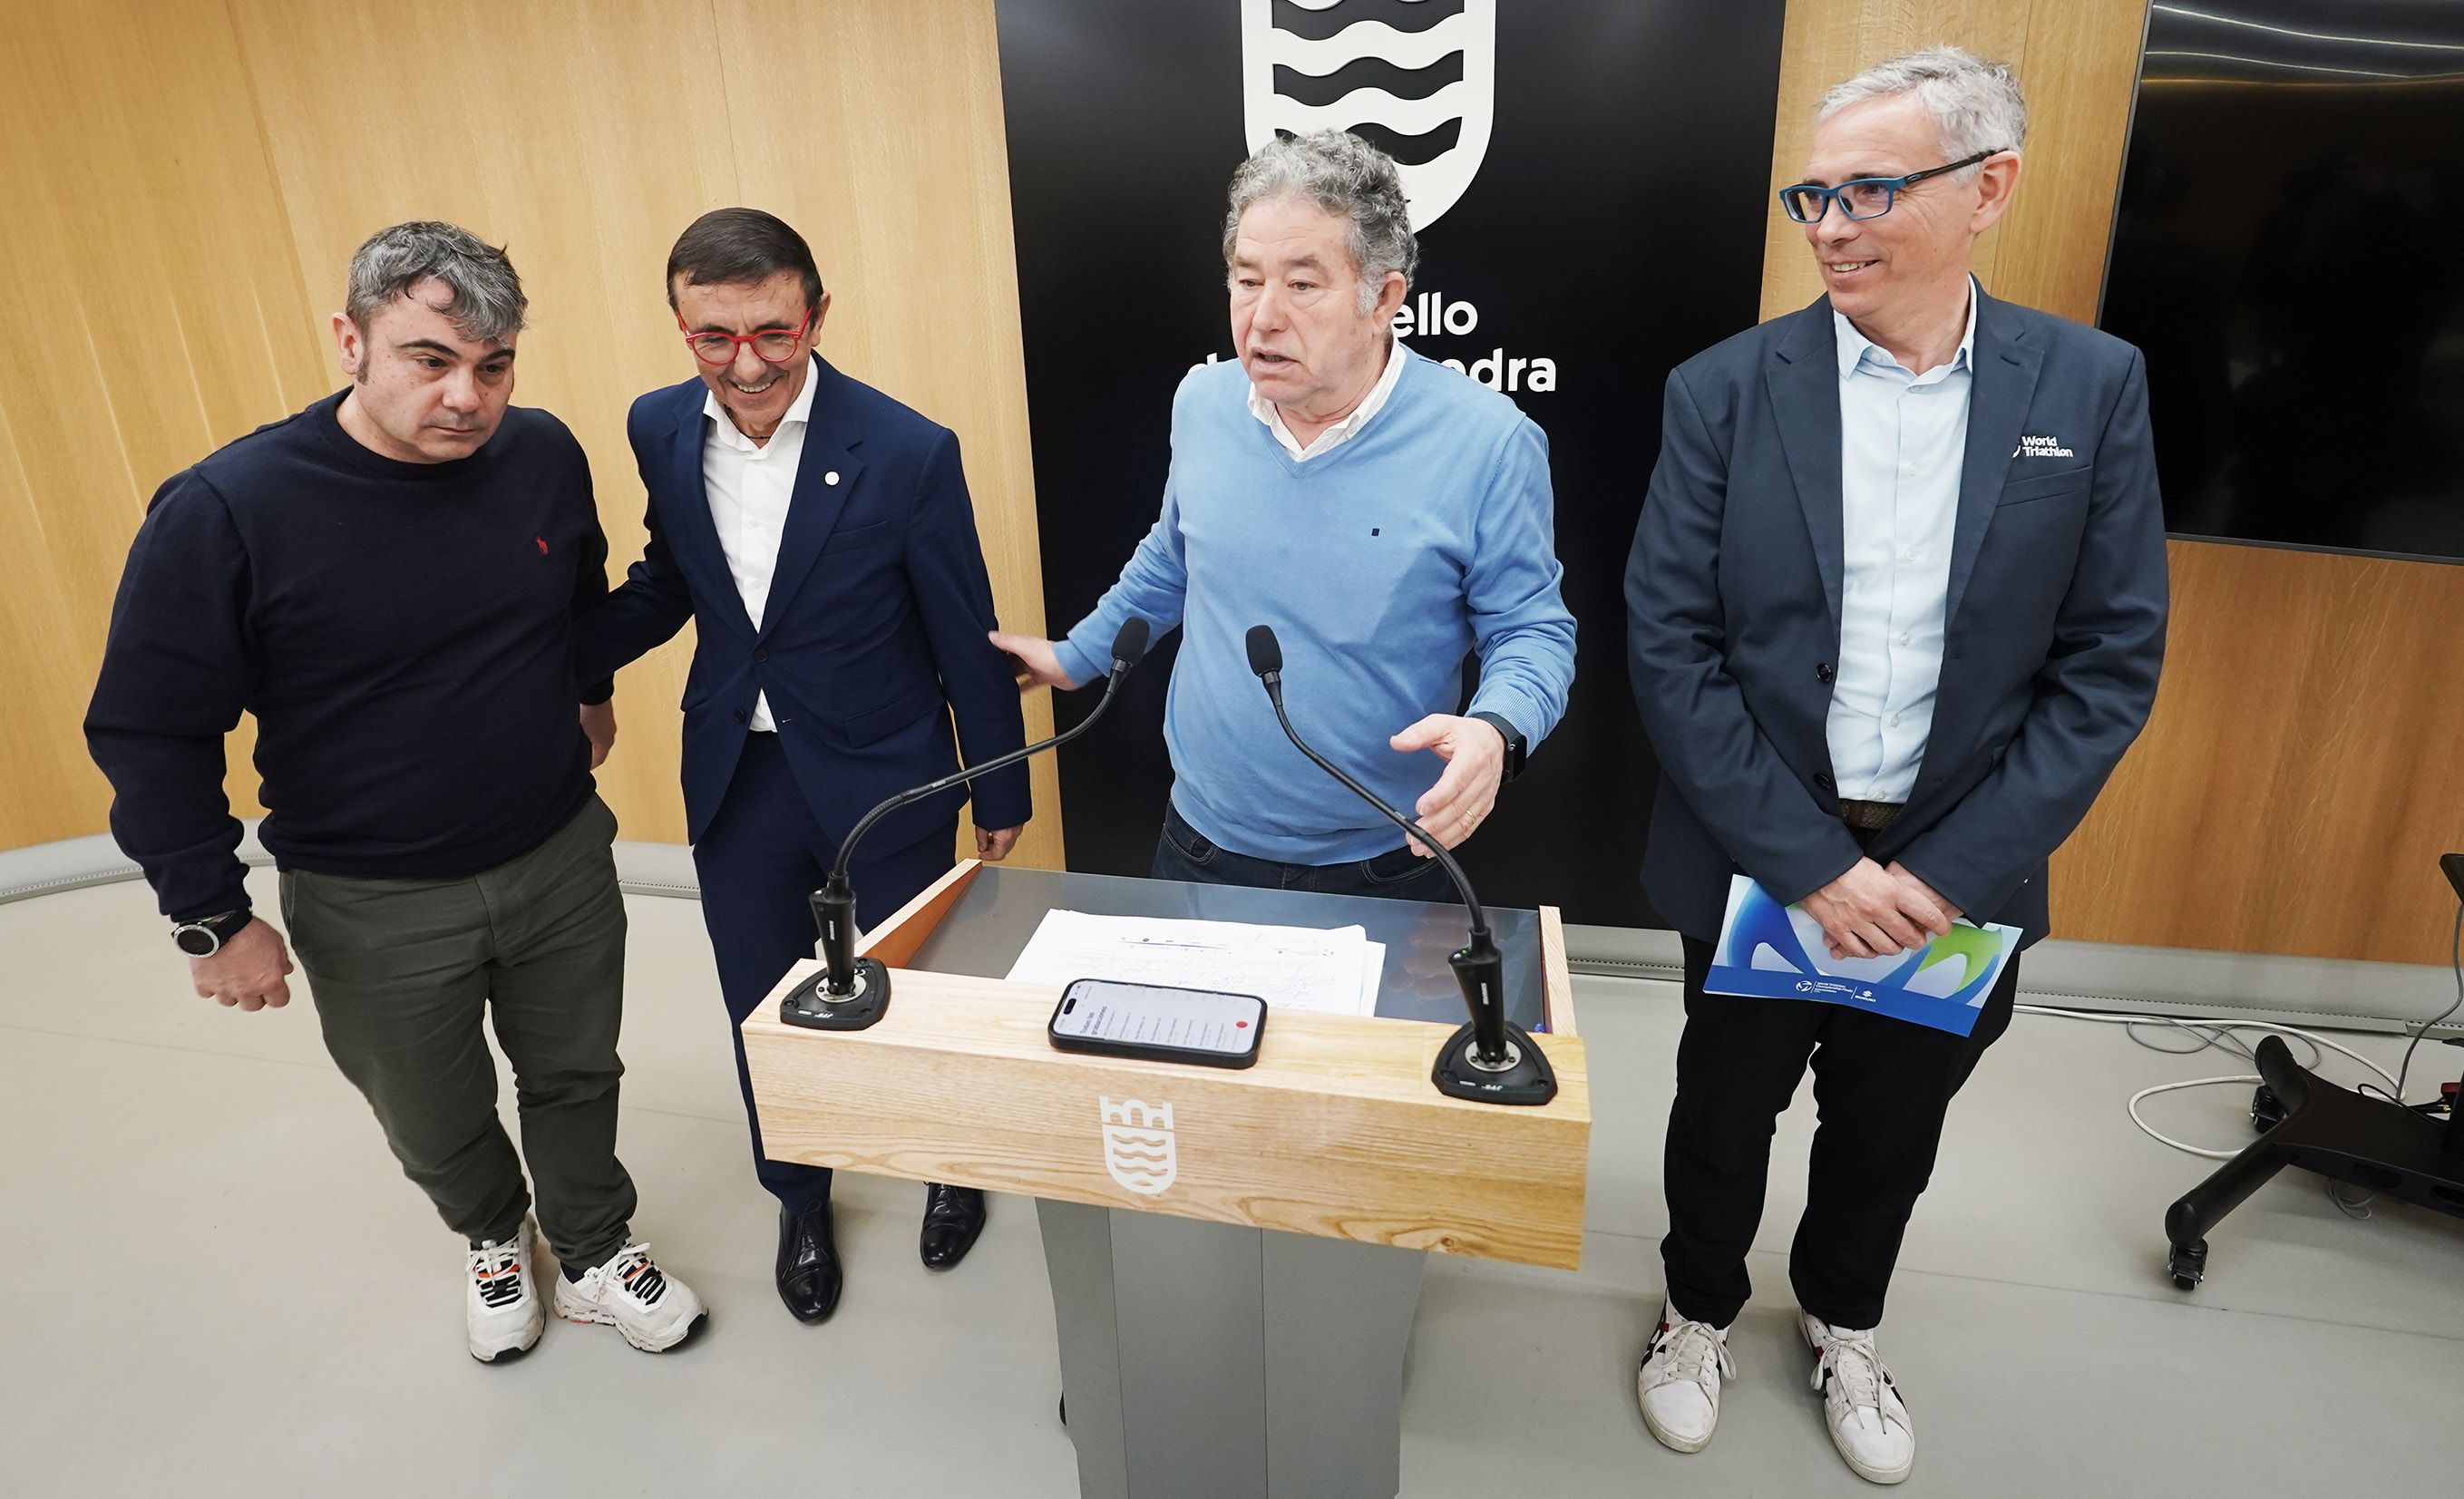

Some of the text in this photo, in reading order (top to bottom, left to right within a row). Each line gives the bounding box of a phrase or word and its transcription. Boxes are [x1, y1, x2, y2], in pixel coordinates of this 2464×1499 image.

[1391, 291, 1478, 338] ello
[2021, 436, 2058, 446] World
[2022, 446, 2073, 457] Triathlon
